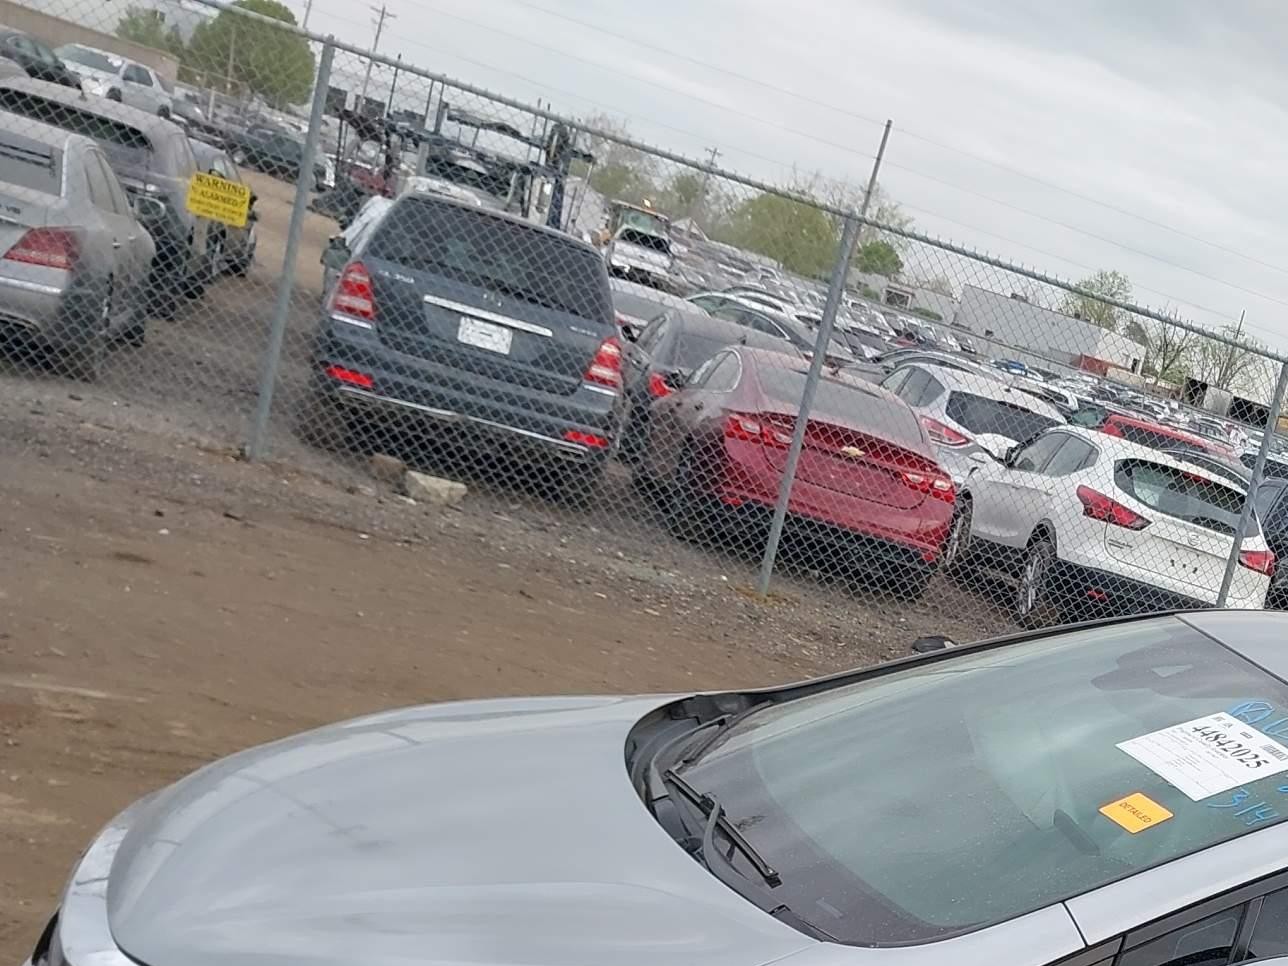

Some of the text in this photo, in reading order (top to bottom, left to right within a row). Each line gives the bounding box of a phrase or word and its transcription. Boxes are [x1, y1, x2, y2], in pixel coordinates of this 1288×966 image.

[195, 173, 247, 197] WARNING
[1191, 726, 1270, 769] 44842025
[1119, 801, 1153, 824] DETAILED
